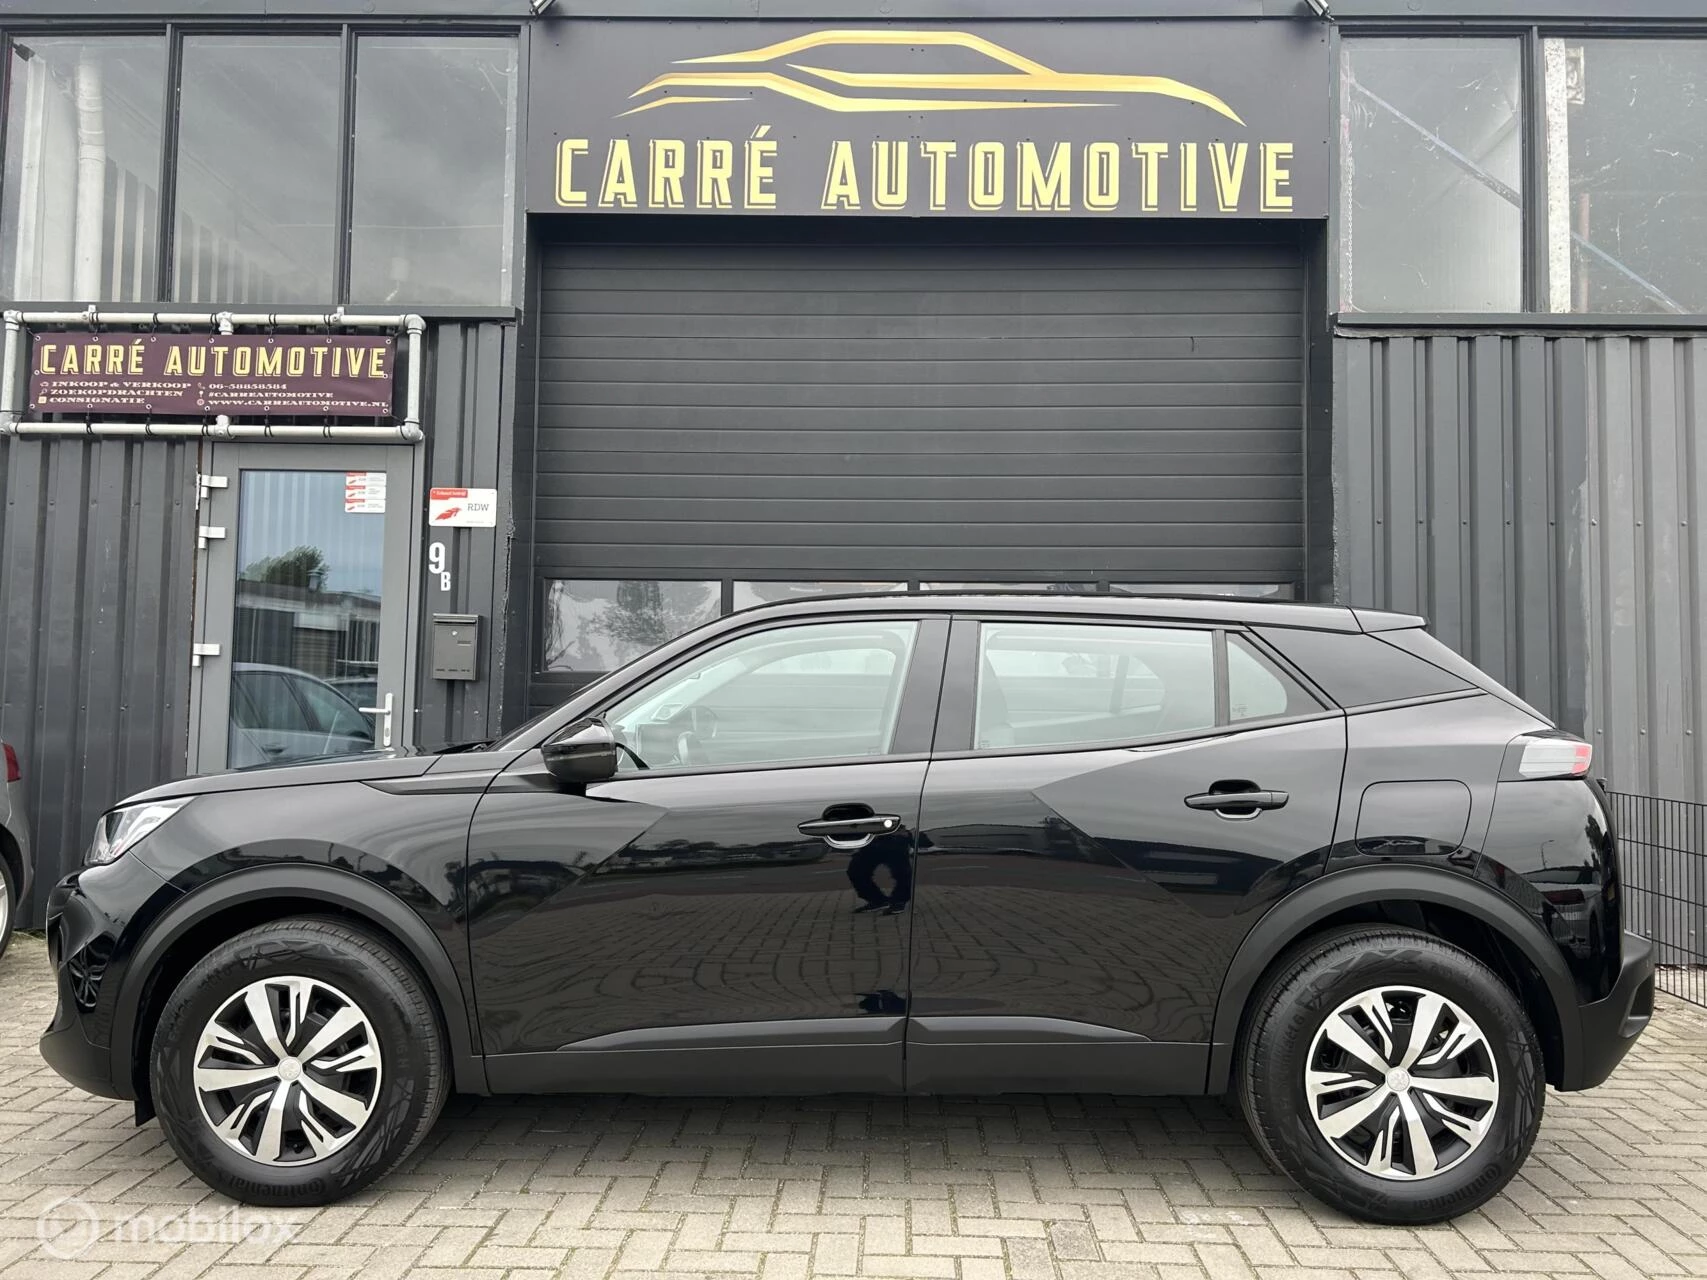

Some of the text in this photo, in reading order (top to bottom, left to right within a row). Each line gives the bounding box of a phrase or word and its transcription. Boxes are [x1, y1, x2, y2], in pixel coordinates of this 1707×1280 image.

[554, 124, 1295, 213] CARRÉ AUTOMOTIVE
[39, 338, 388, 378] CARRÉ AUTOMOTIVE
[50, 388, 184, 397] ZOEKOPDRACHTEN
[467, 503, 490, 512] RDW
